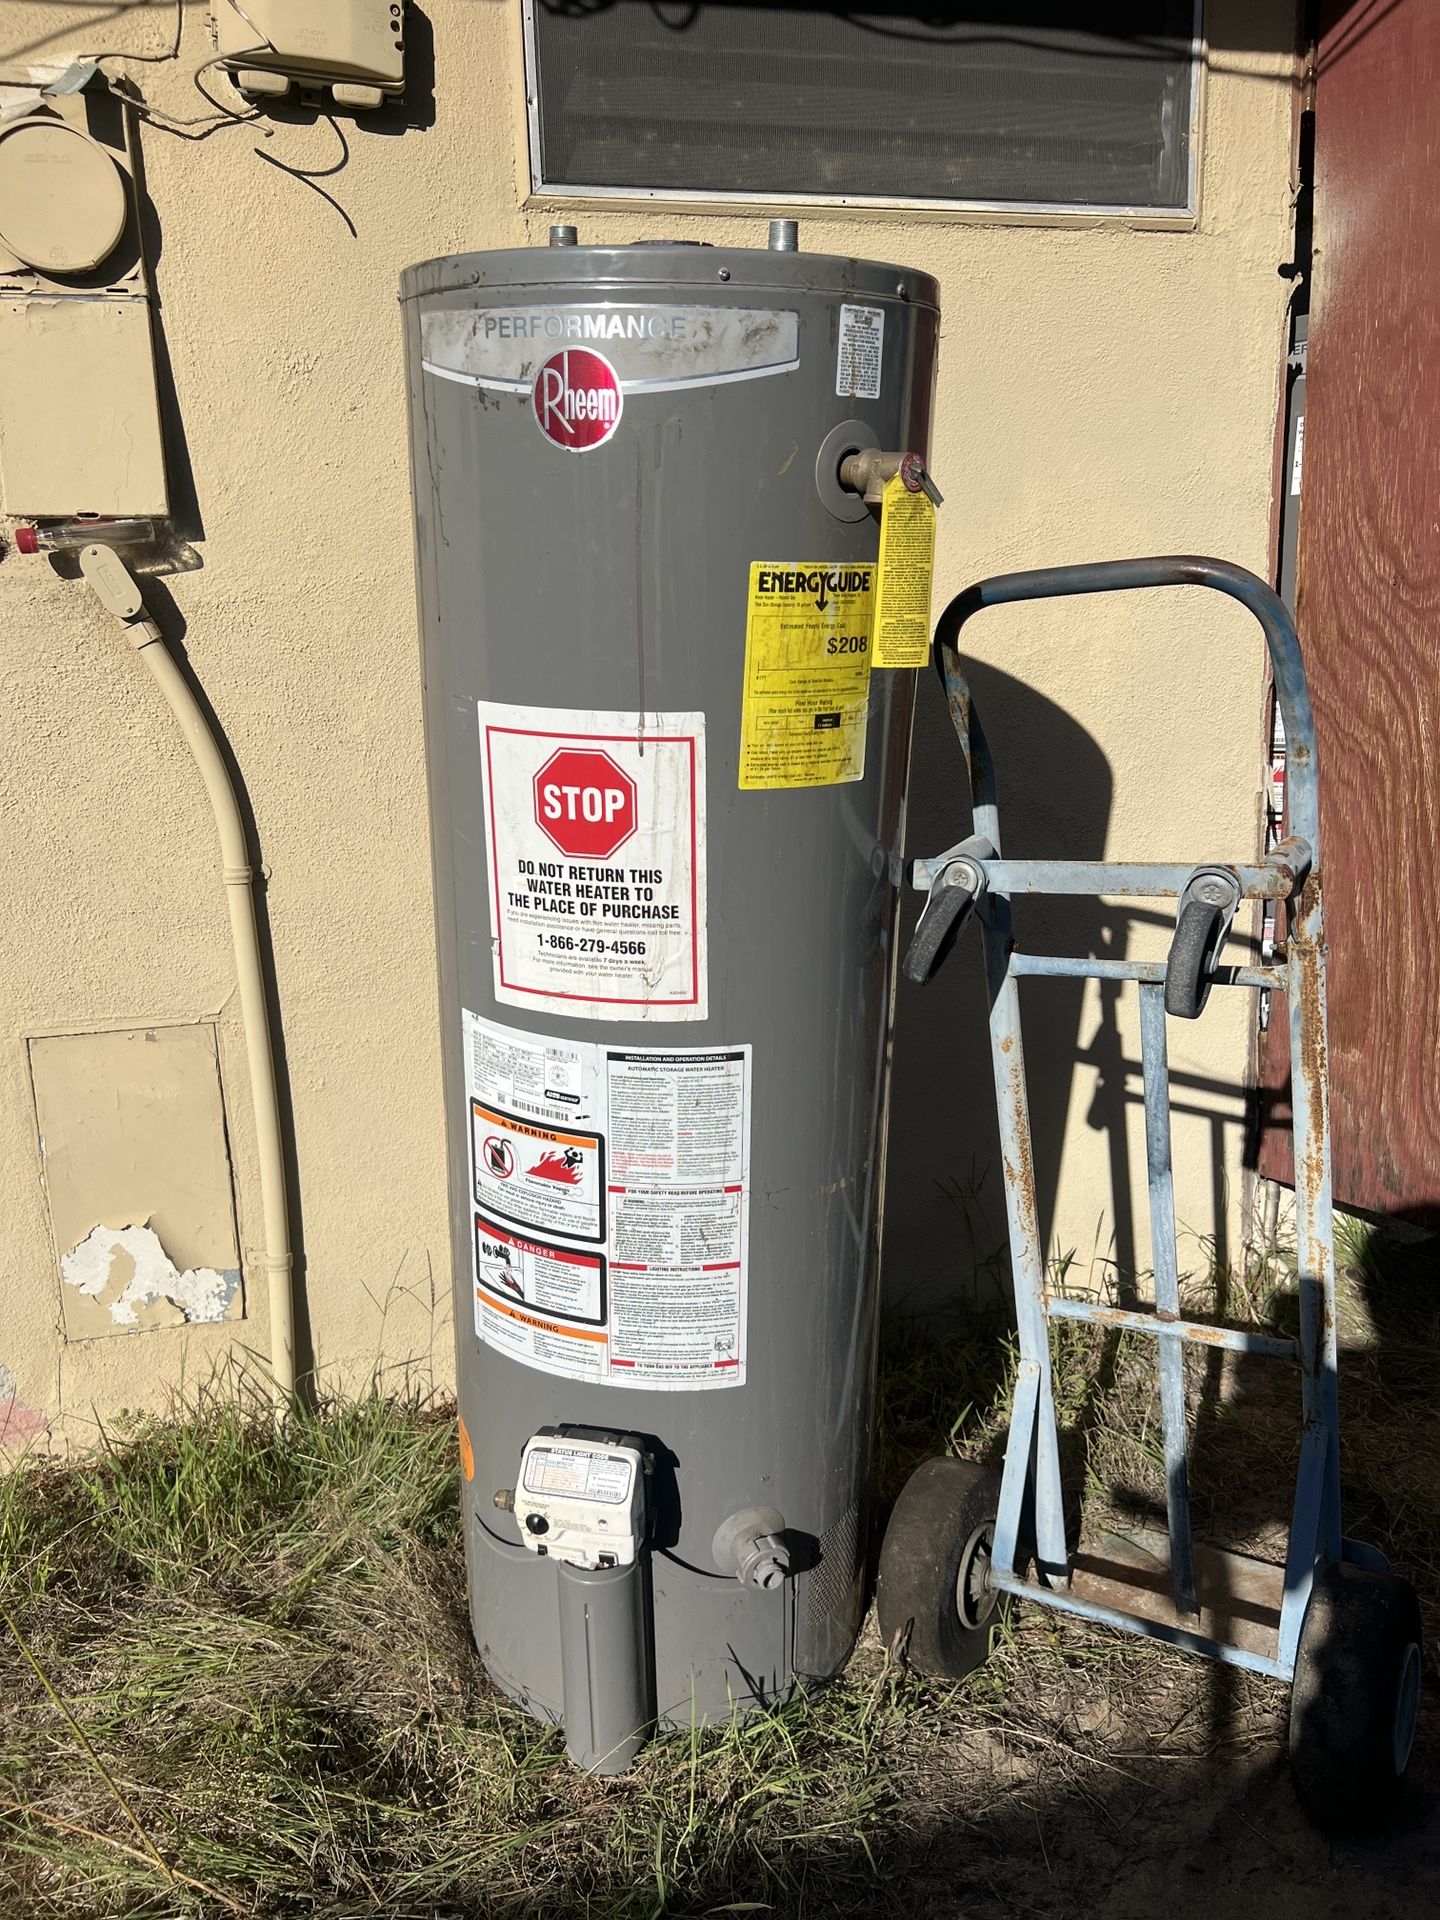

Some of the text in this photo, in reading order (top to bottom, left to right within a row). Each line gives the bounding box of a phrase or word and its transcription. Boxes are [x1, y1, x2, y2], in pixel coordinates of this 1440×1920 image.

[485, 314, 686, 339] PERFORMANCE
[542, 351, 616, 434] Rheem
[758, 571, 871, 592] ENERGYGUIDE
[827, 636, 868, 654] $208
[543, 784, 626, 823] STOP
[518, 859, 663, 884] DO NOT RETURN THIS
[526, 878, 653, 902] WATER HEATER TO
[508, 892, 680, 919] THE PLACE OF PURCHASE
[520, 918, 545, 927] installation
[596, 927, 617, 935] general
[529, 913, 561, 923] experiencing
[562, 916, 579, 924] issues
[537, 933, 646, 955] 1-866-279-4566
[510, 1121, 557, 1141] WARNING
[516, 1241, 556, 1259] DANGER
[519, 1313, 560, 1333] WARNING
[551, 1448, 572, 1456] STATUS
[573, 1450, 592, 1458] LIGHT
